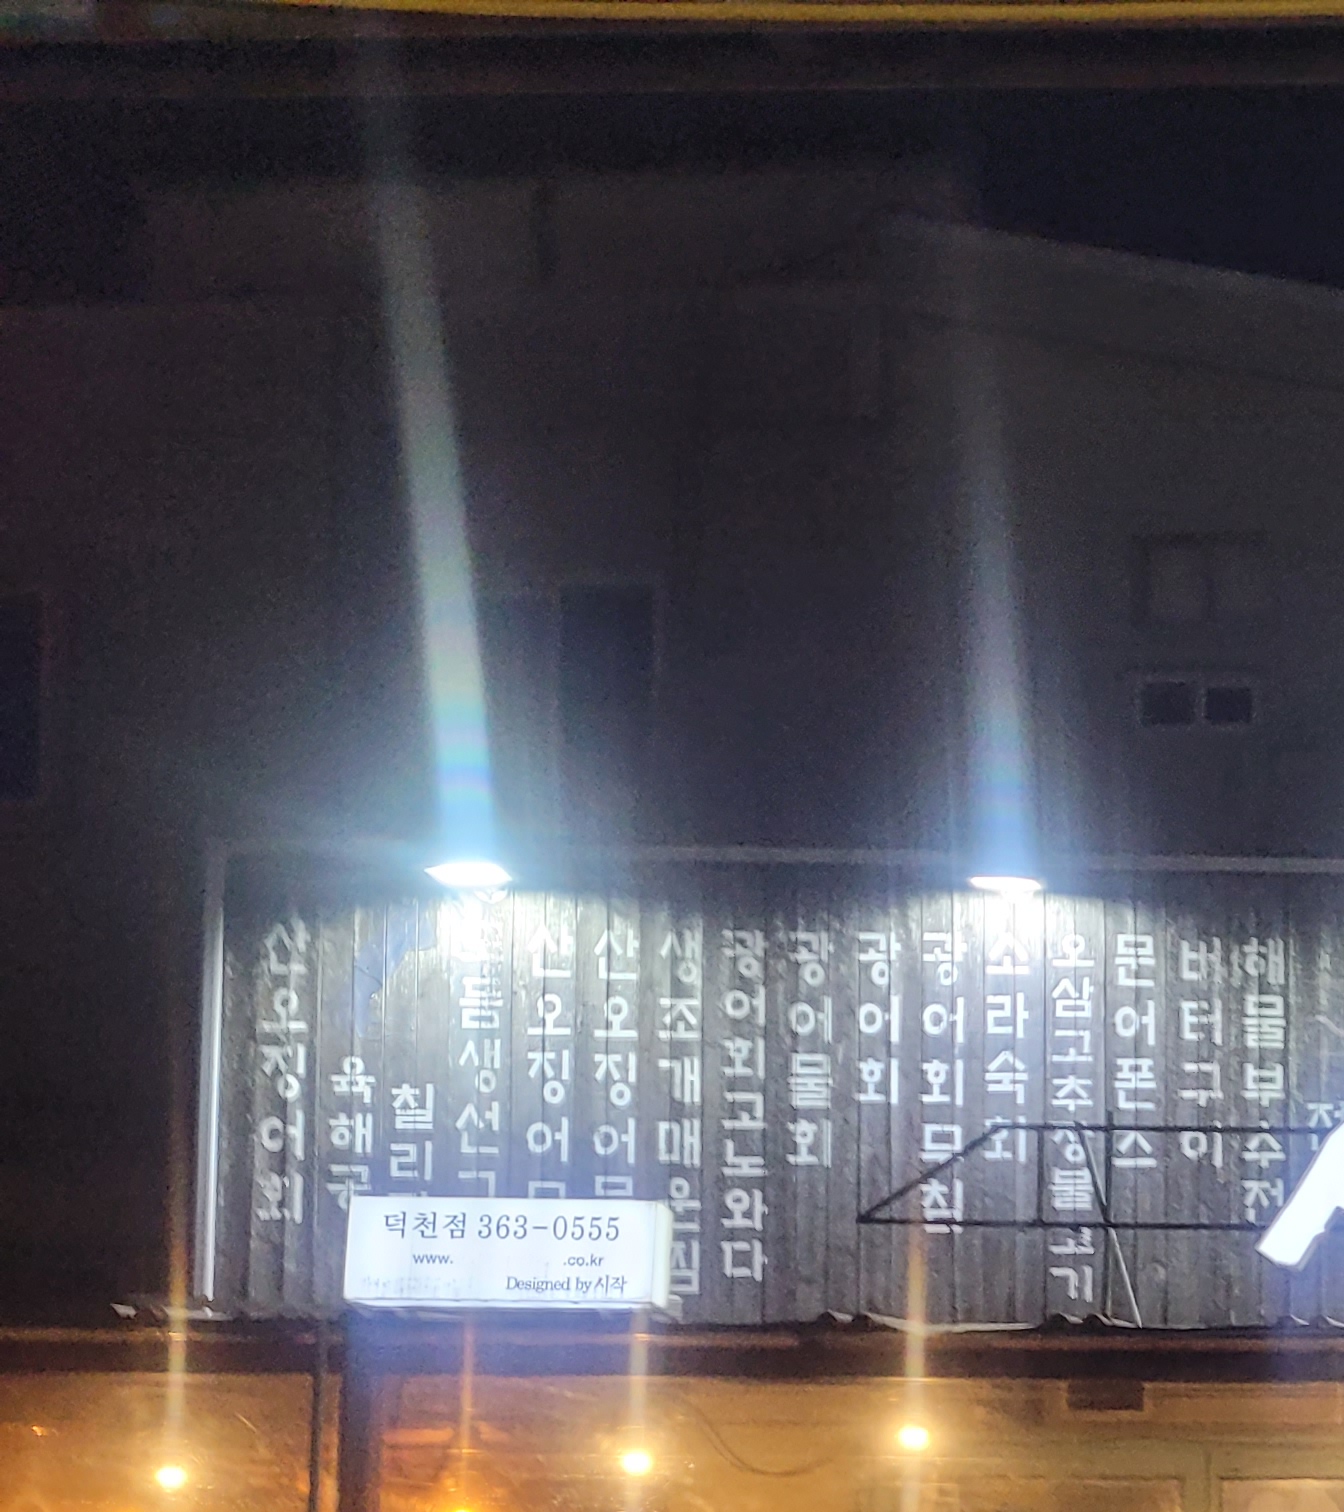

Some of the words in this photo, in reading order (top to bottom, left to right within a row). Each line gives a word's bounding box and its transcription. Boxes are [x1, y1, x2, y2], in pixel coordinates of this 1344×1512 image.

[786, 929, 835, 1169] 광어물회
[854, 931, 901, 1107] 광어회
[919, 931, 968, 1234] 광어회무침
[983, 931, 1031, 1164] 소라숙회
[1177, 935, 1225, 1169] 버터구이
[384, 1211, 467, 1240] 덕천점
[478, 1214, 620, 1241] 363-0555
[412, 1254, 454, 1265] www.
[563, 1255, 604, 1268] .co.kr
[506, 1276, 571, 1294] Designed
